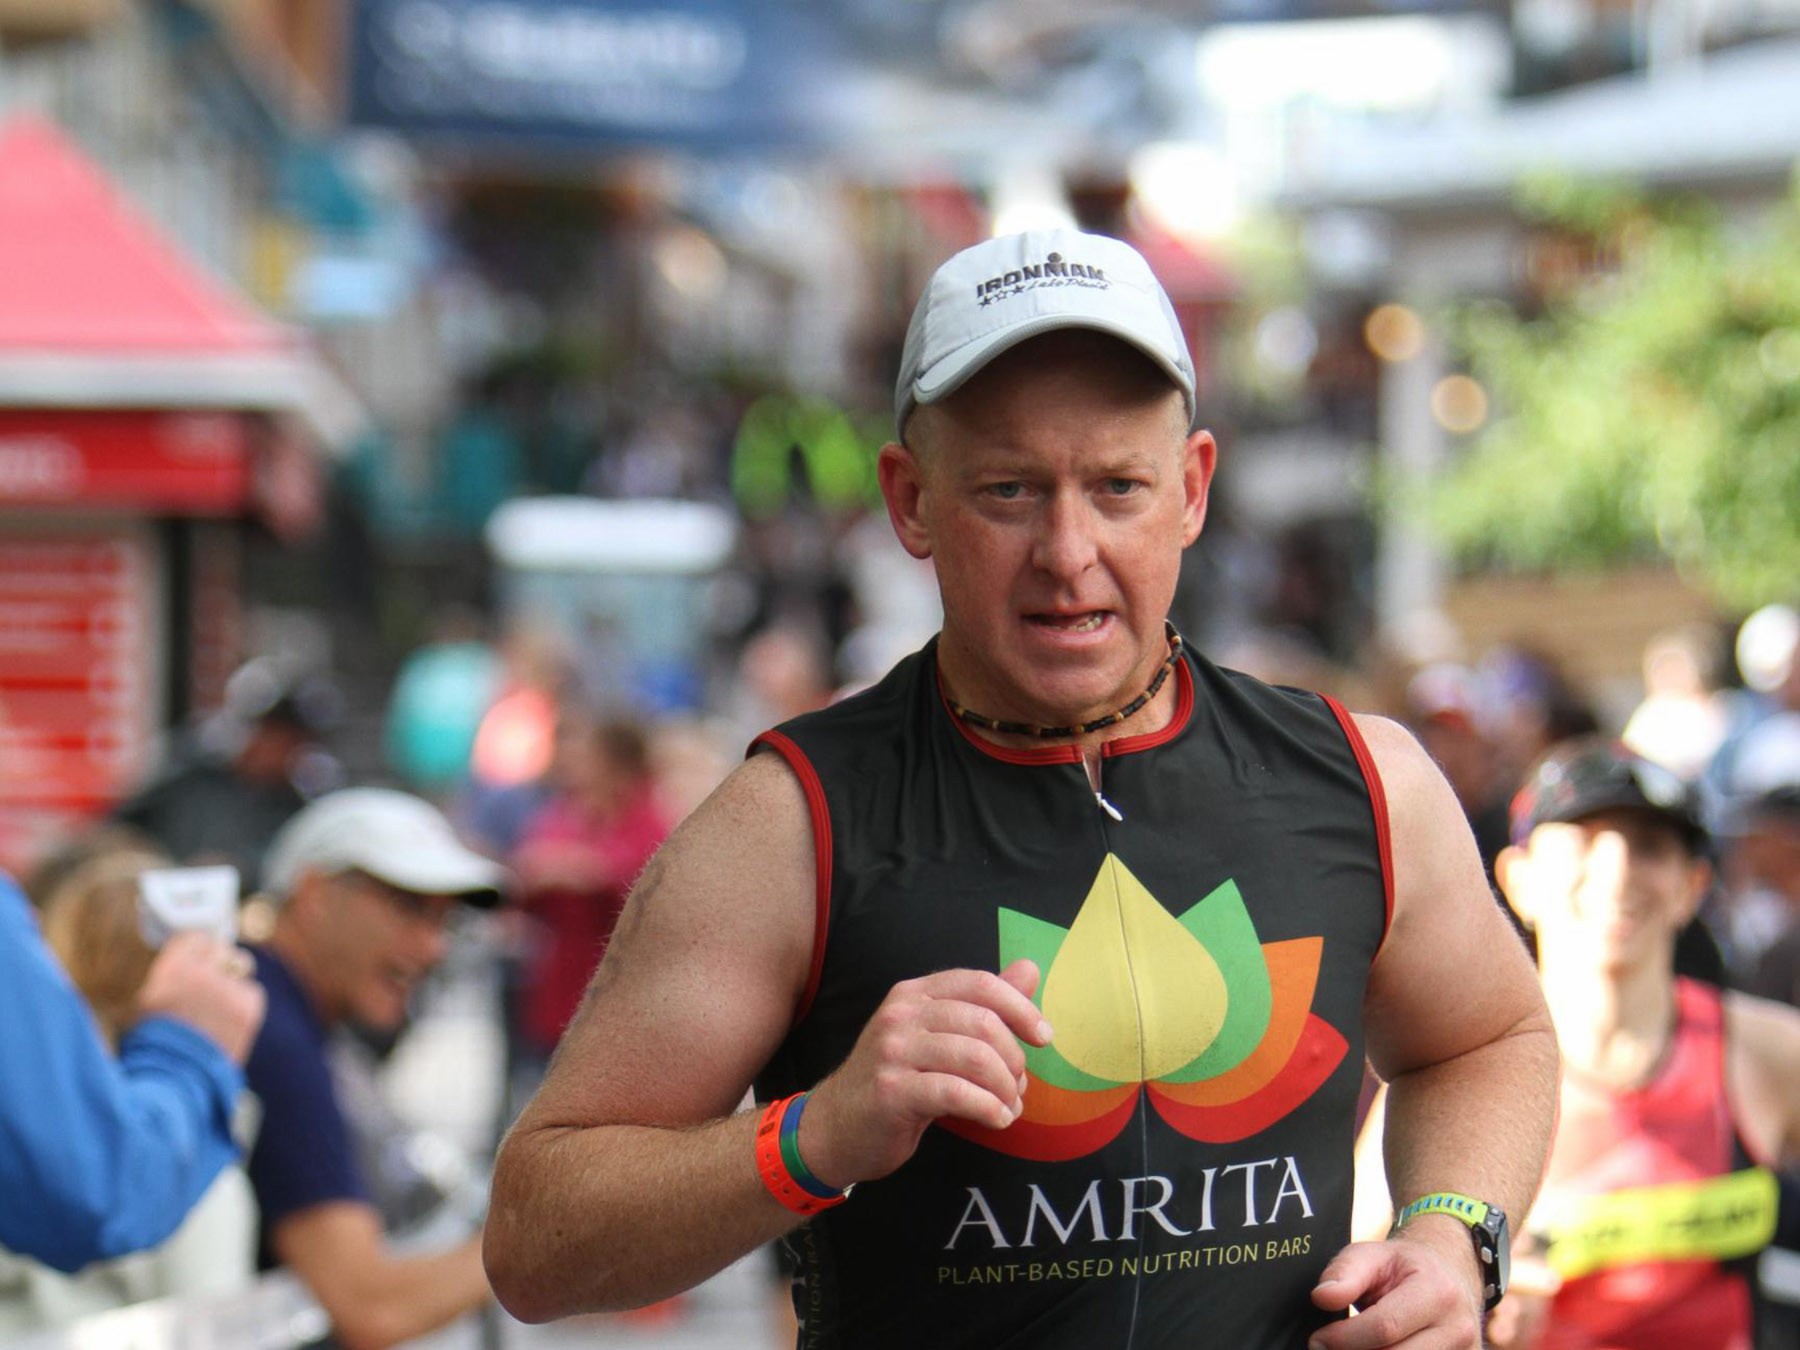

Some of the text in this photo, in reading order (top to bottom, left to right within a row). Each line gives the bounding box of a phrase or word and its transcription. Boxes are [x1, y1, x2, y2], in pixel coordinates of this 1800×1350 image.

[976, 253, 1105, 298] IRONMAN
[944, 1156, 1315, 1250] AMRITA
[938, 1234, 1312, 1285] PLANT-BASED NUTRITION BARS
